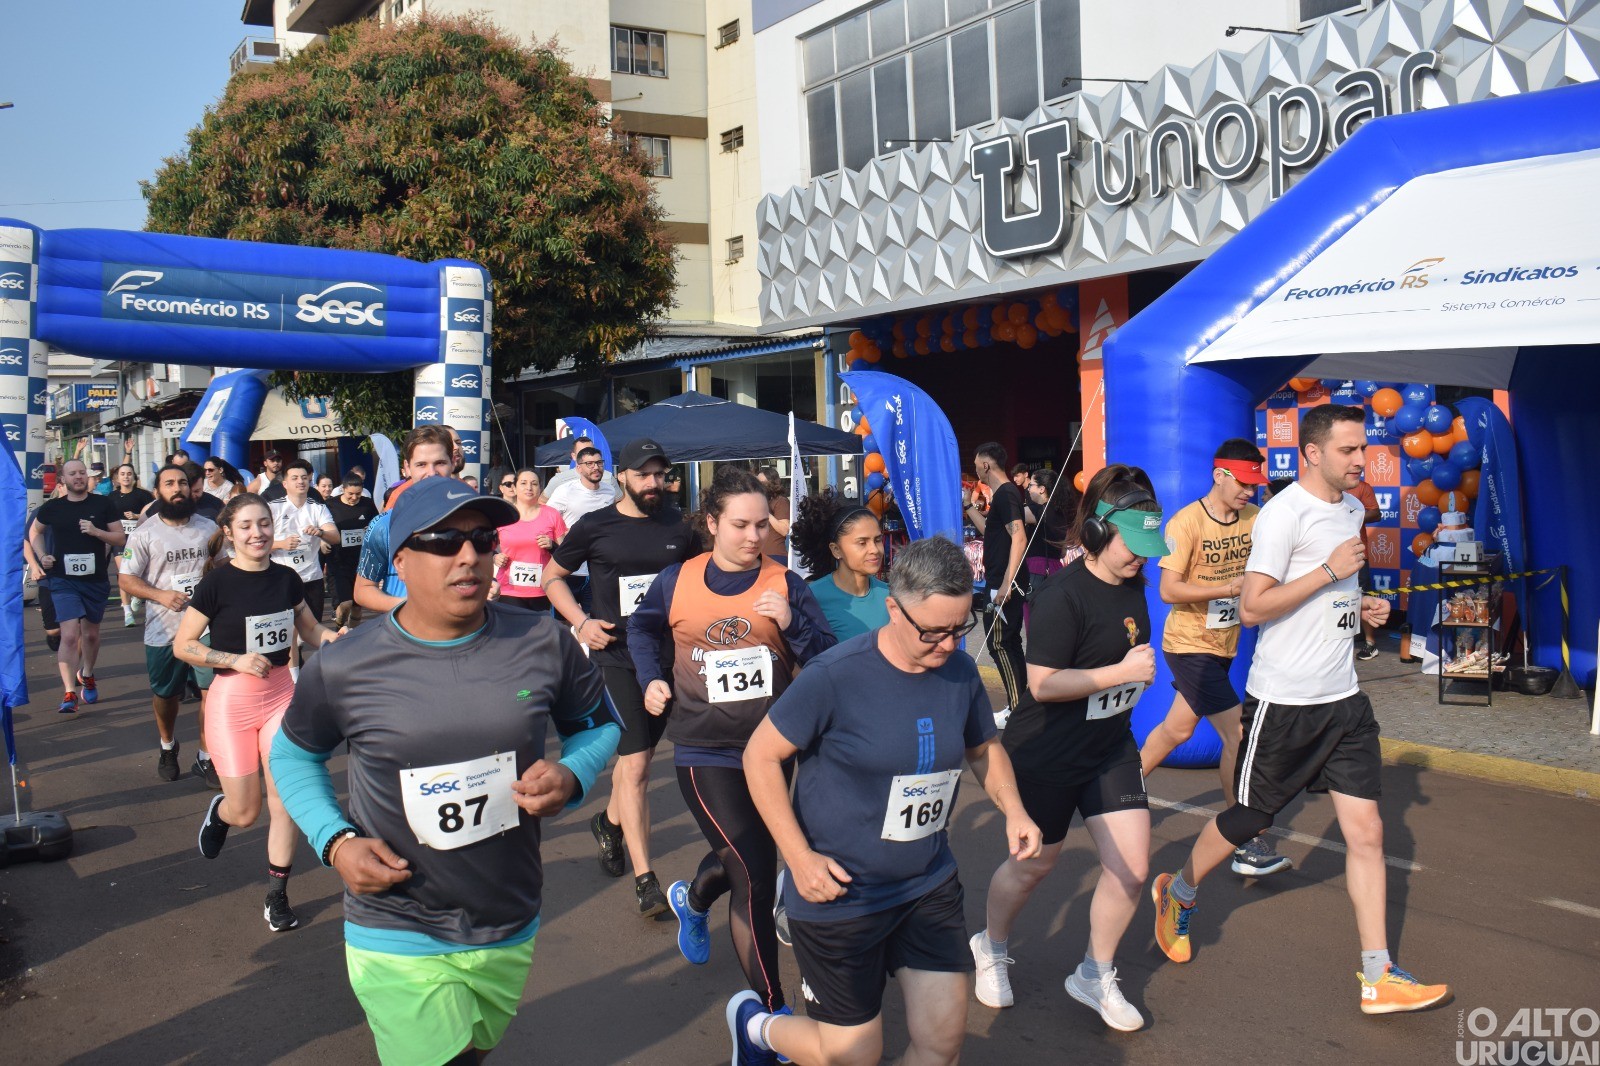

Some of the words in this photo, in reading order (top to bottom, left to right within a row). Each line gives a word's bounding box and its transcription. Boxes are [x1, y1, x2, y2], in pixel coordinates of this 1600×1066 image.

[1093, 49, 1437, 205] unopar
[0, 279, 24, 290] esc
[1284, 278, 1394, 302] Fecomércio
[1400, 274, 1429, 290] RS
[1460, 265, 1579, 285] Sindicatos
[122, 294, 237, 317] Fecomércio
[243, 303, 270, 320] RS
[295, 292, 384, 326] Sesc
[1440, 301, 1496, 312] Sistema
[1499, 296, 1566, 308] Comércio
[454, 311, 480, 323] Sesc
[0, 355, 22, 366] esc
[451, 377, 478, 389] Sesc
[416, 410, 438, 421] Sesc
[288, 423, 342, 435] unopa
[1366, 429, 1388, 438] unop
[1269, 470, 1297, 478] unopar
[1203, 533, 1252, 551] RÚSTIC
[292, 555, 305, 564] 61
[1205, 552, 1220, 563] 10
[72, 563, 87, 572] 80
[514, 573, 537, 583] 174
[628, 582, 646, 590] Sesc
[634, 592, 646, 605] 4
[1332, 600, 1350, 608] Sesc
[254, 621, 272, 630] Sesc
[1337, 611, 1356, 630] 40
[254, 628, 288, 648] 136
[715, 659, 739, 668] Sesc
[717, 669, 765, 693] 134
[1098, 687, 1137, 710] 117
[420, 779, 461, 796] Sesc
[466, 767, 501, 782] Fecomércio
[467, 778, 486, 789] Senac
[902, 786, 928, 798] Sesc
[437, 793, 489, 834] 87
[900, 798, 944, 829] 169
